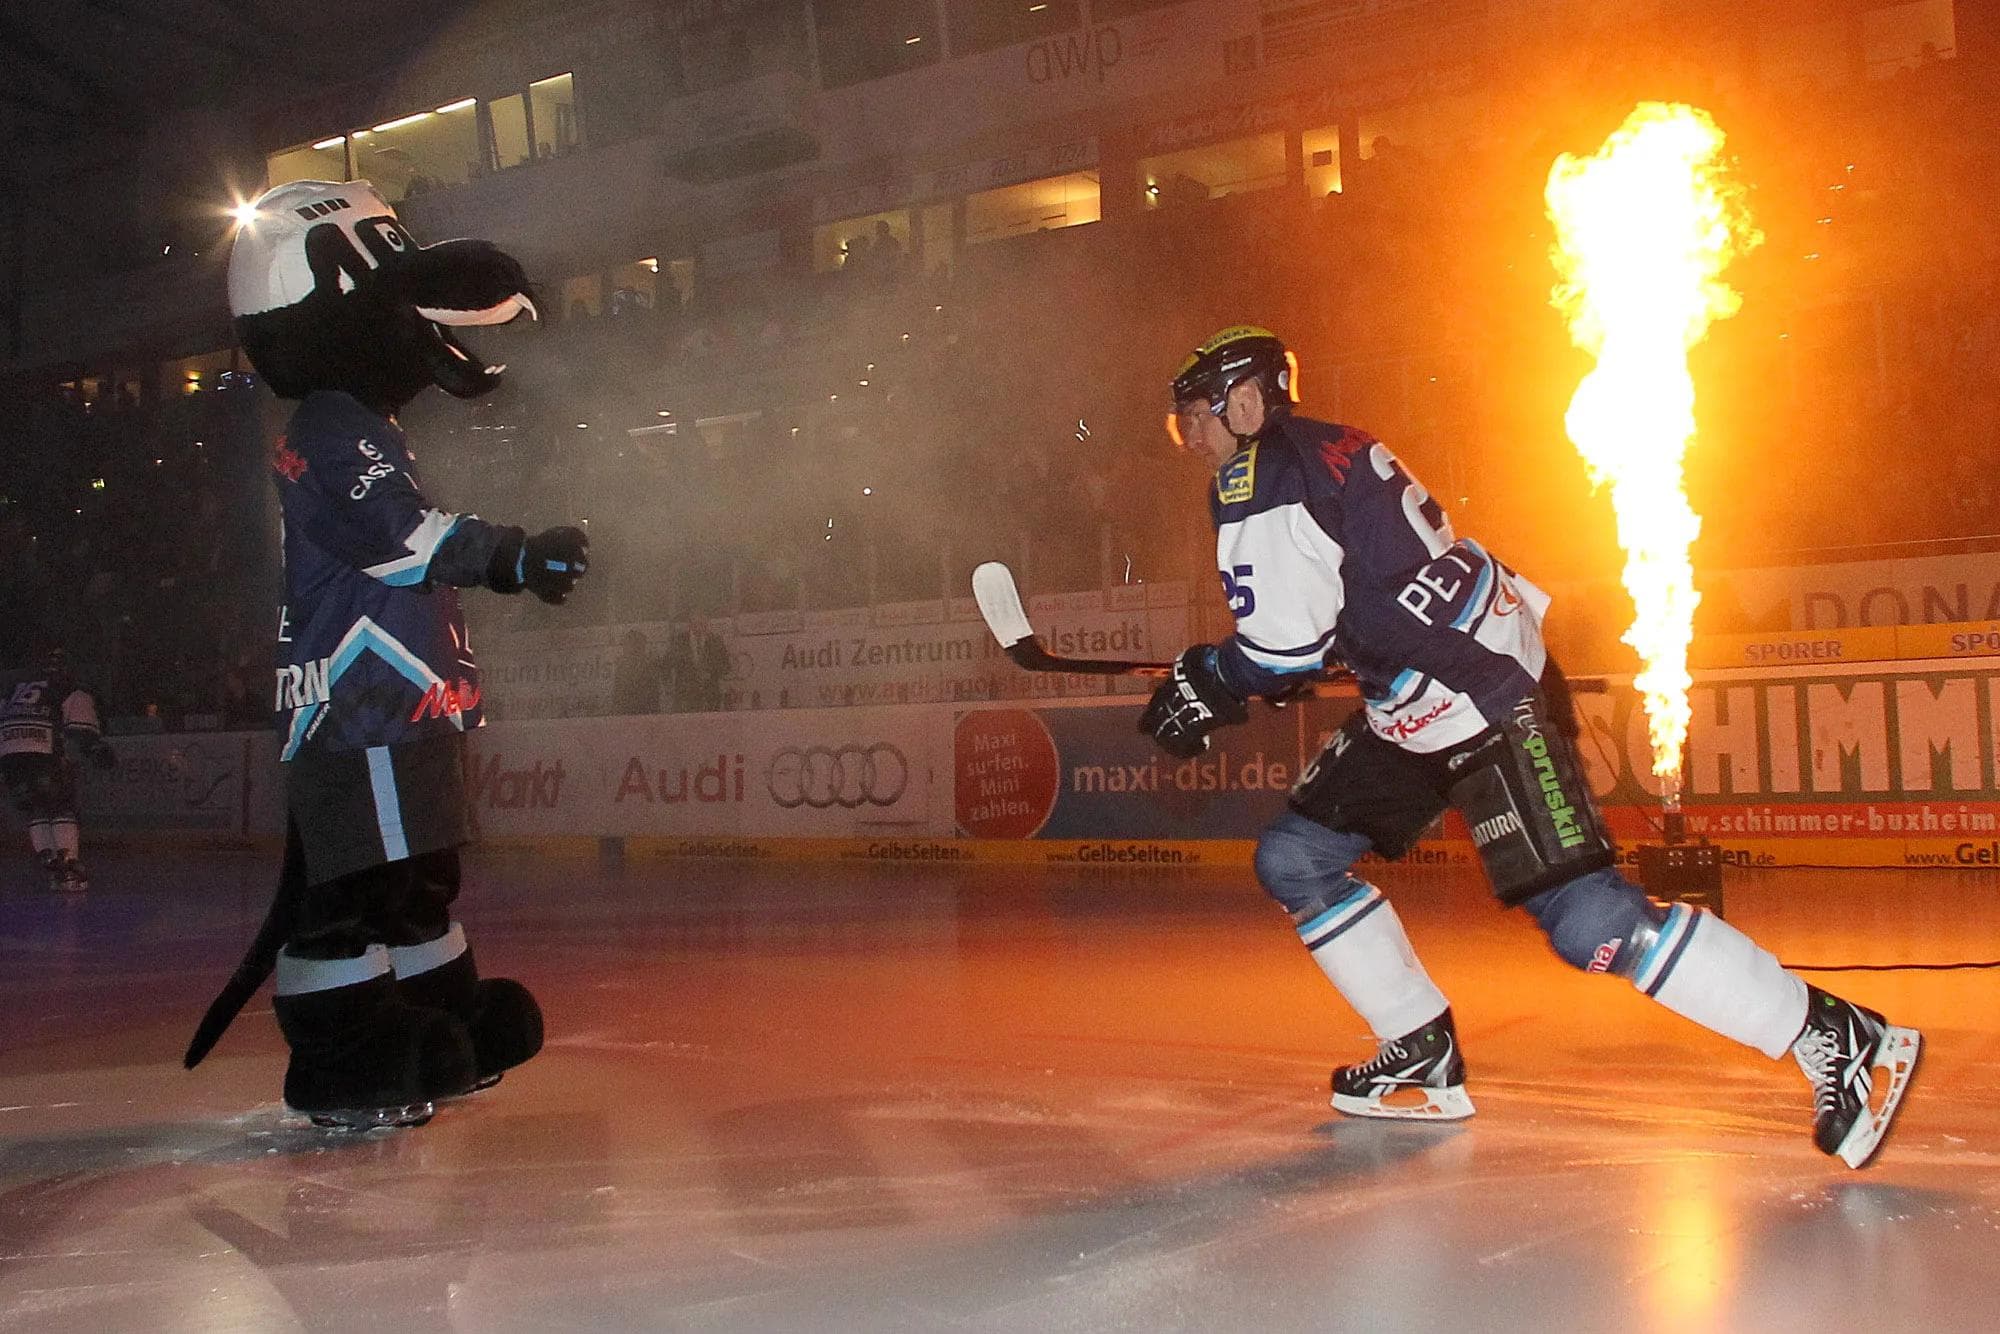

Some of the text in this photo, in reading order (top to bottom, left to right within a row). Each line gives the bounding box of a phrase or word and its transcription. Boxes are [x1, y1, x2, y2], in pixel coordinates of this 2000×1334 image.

[781, 640, 841, 671] Audi
[850, 634, 973, 667] Zentrum
[974, 733, 1017, 752] Maxi
[1566, 676, 2000, 799] SCHIMM
[614, 754, 745, 804] Audi
[966, 753, 1030, 778] surfen.
[1072, 751, 1289, 793] maxi-dsl.de
[979, 774, 1021, 799] Mini
[969, 797, 1036, 823] zahlen.
